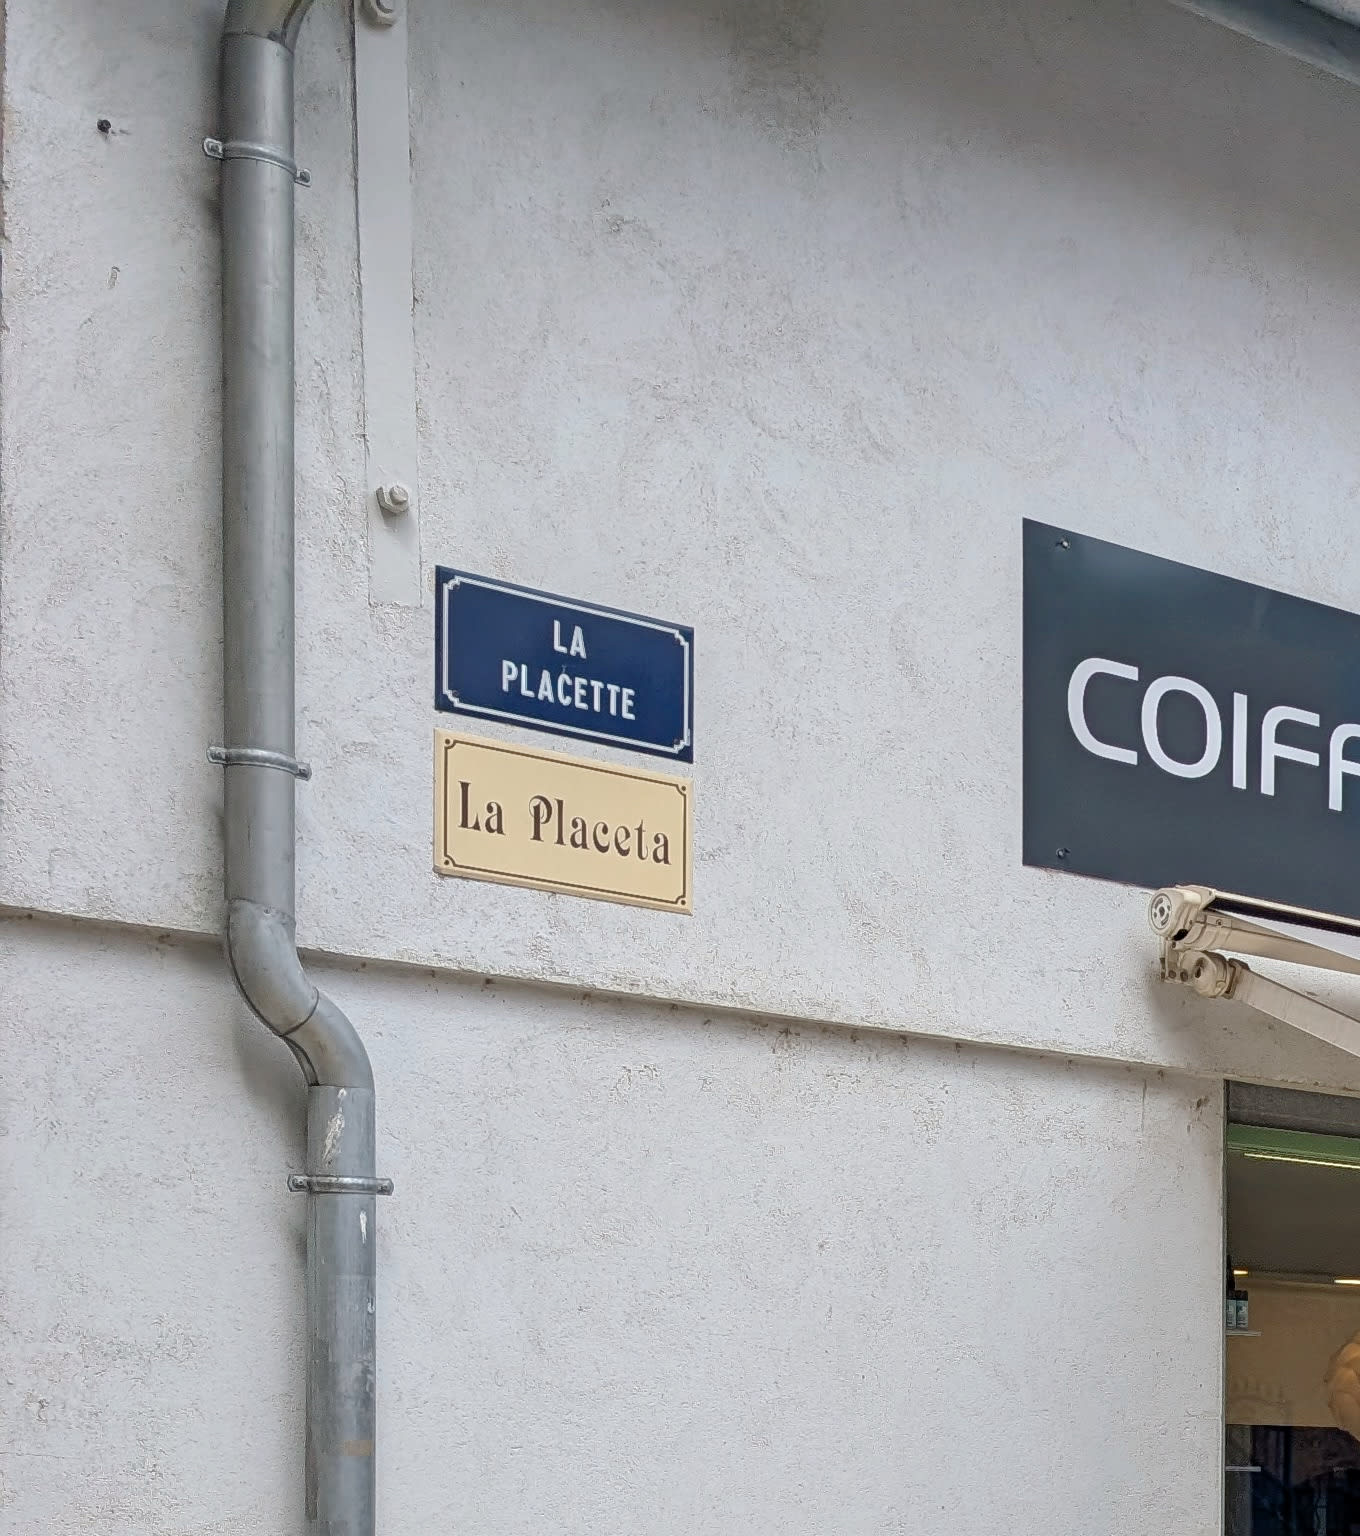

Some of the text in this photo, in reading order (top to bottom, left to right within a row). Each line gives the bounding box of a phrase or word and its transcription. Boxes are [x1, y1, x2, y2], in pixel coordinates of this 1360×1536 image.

[553, 619, 587, 659] LA
[502, 659, 636, 720] PLACETTE
[457, 780, 672, 865] La Placeta
